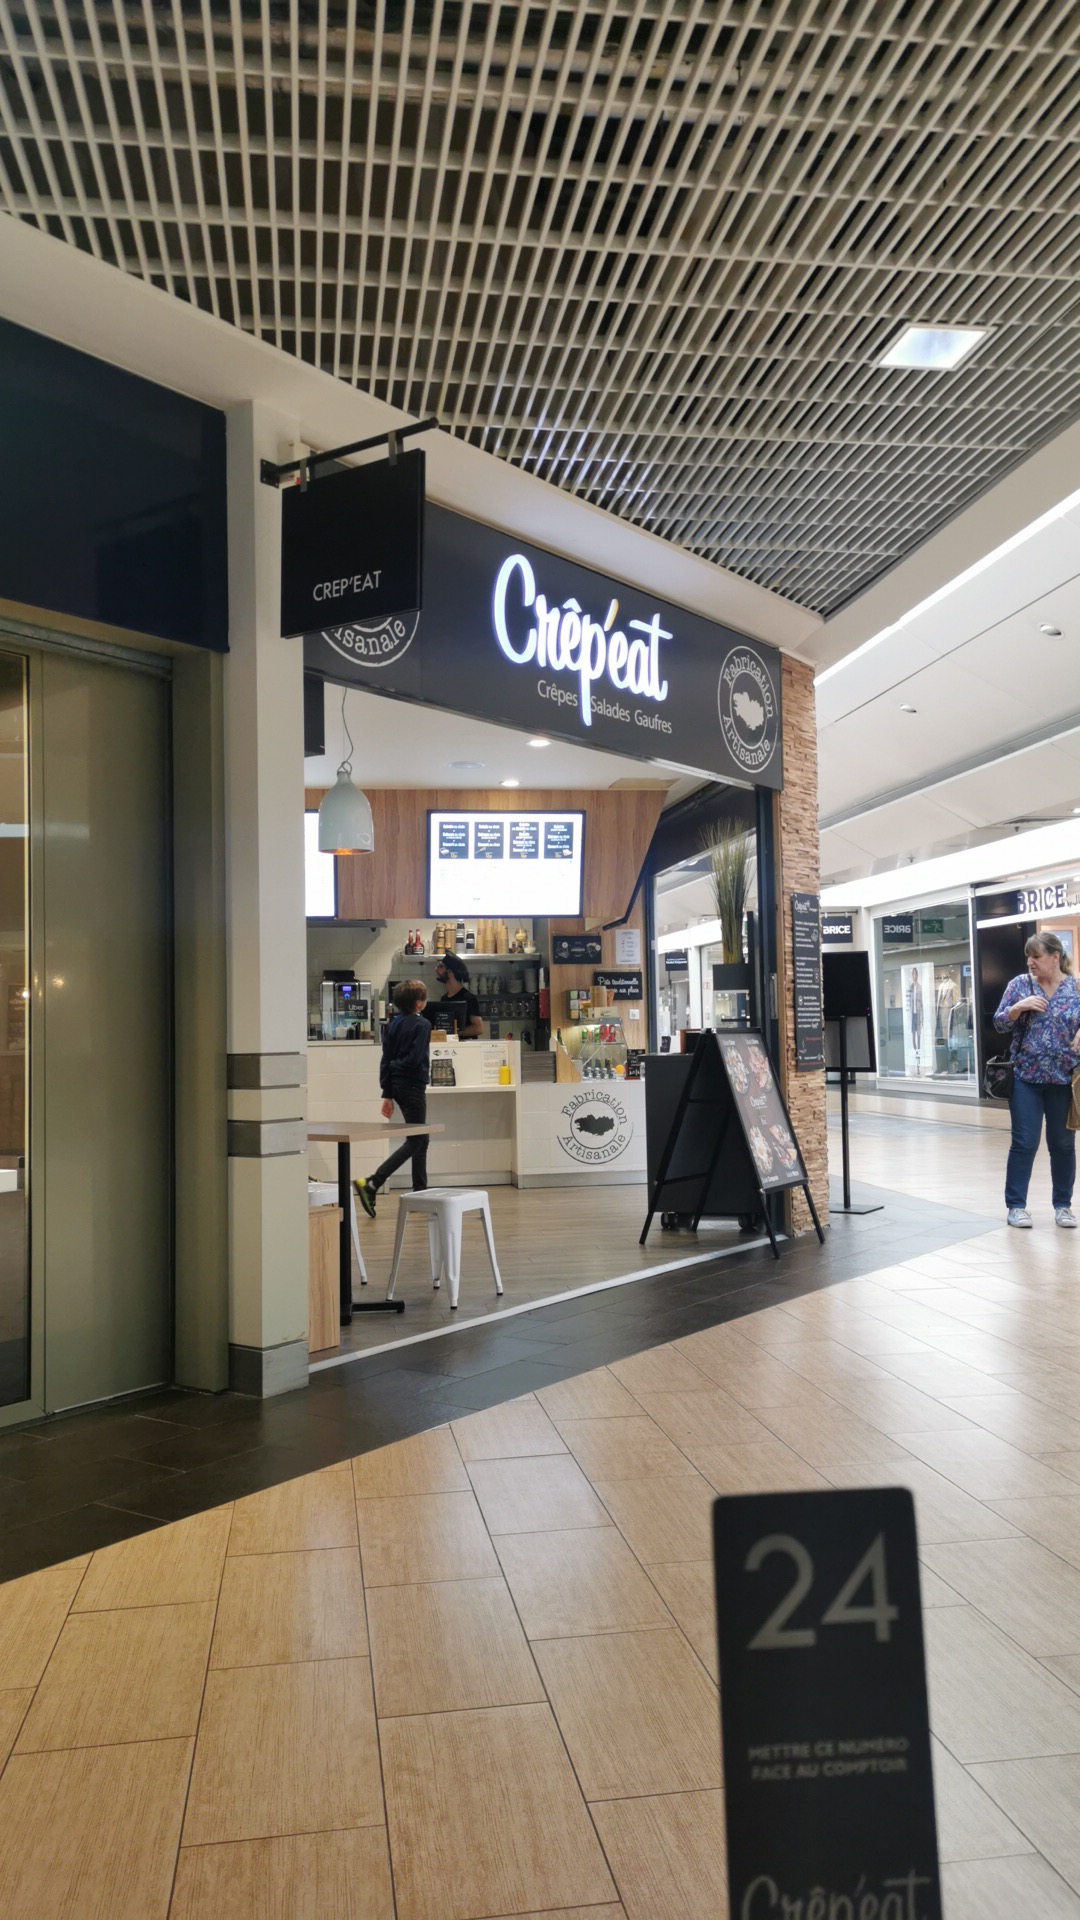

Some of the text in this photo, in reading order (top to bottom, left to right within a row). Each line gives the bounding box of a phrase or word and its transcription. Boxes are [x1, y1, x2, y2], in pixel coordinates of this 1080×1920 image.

[312, 570, 382, 602] CREP'EAT
[331, 620, 406, 655] isanale
[493, 554, 674, 727] Crêp'eat
[723, 655, 774, 719] Fabrication
[537, 680, 673, 734] Crêpes Salades Gaufres
[723, 714, 771, 765] Artisanale
[1017, 884, 1066, 914] BRICE
[822, 925, 851, 935] BRICE
[561, 1089, 627, 1125] Fabrication
[562, 1134, 626, 1160] Artisanale
[745, 1532, 898, 1650] 24
[748, 1743, 811, 1760] METTRE
[814, 1741, 834, 1757] CE
[752, 1758, 908, 1780] FACE AU COMPTOIR
